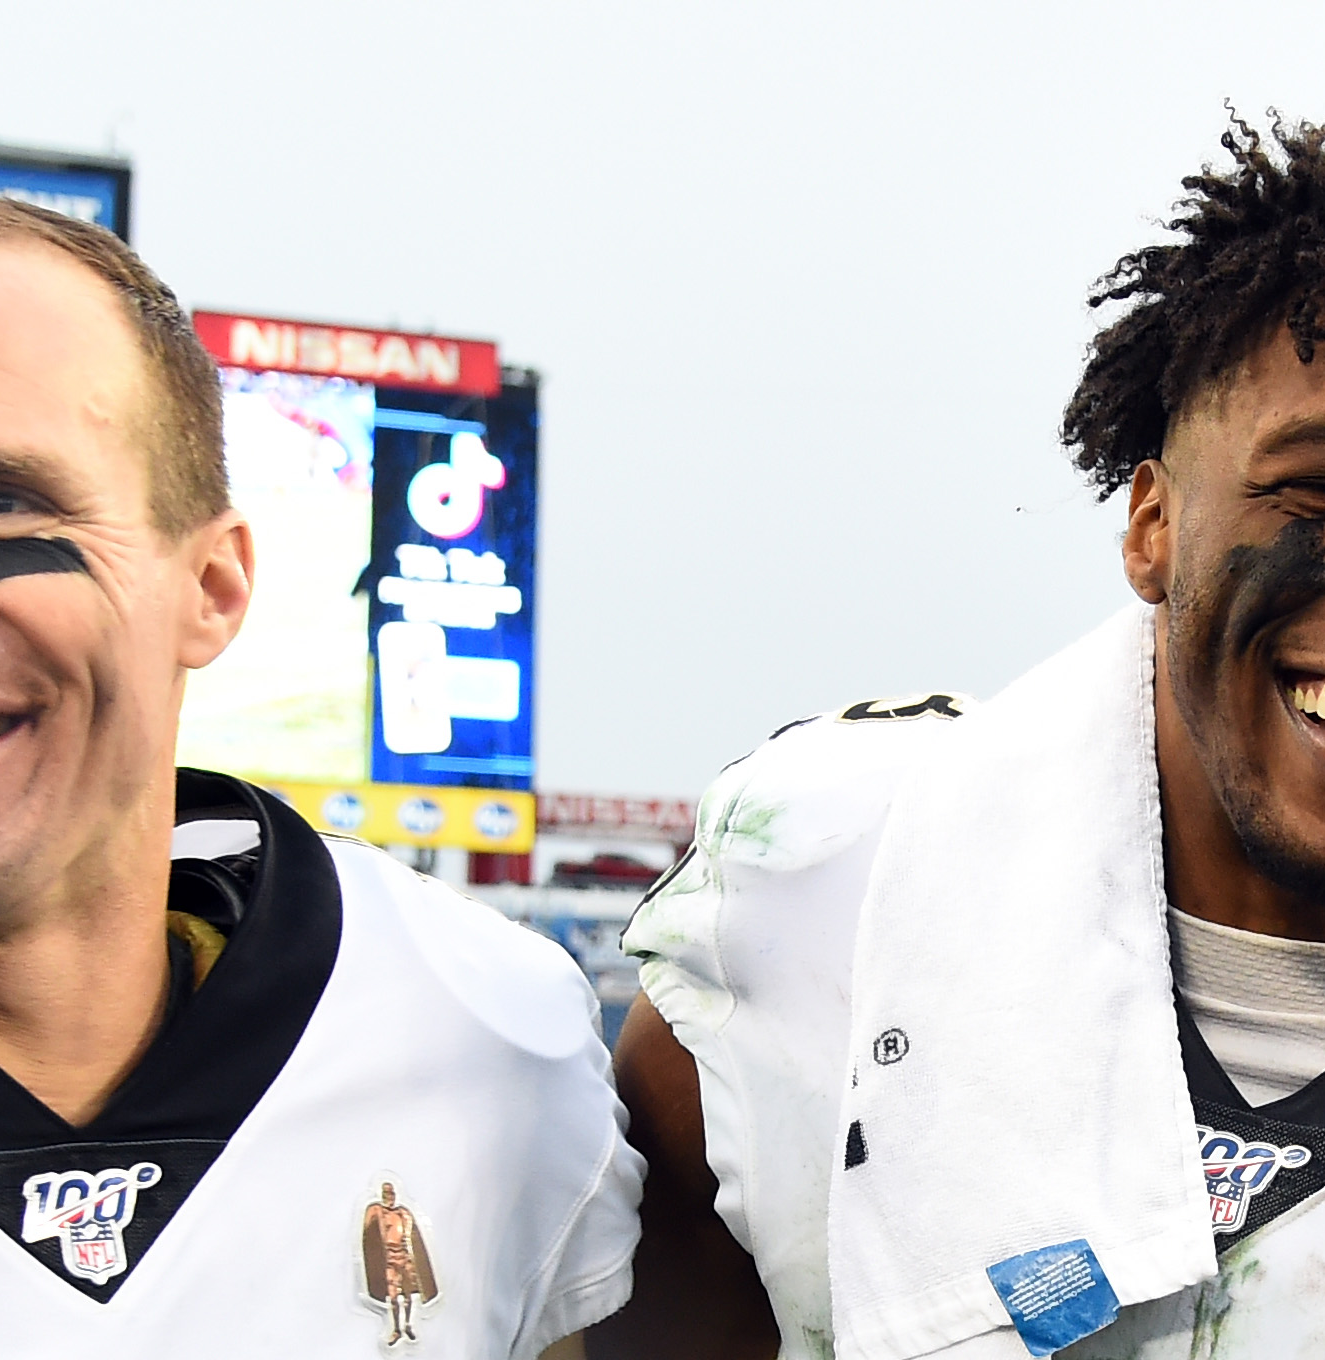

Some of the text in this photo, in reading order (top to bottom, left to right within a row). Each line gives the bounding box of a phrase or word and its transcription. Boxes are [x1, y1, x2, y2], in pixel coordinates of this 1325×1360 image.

[229, 317, 460, 387] NISSAN
[538, 792, 697, 828] NISSA
[75, 1241, 117, 1269] NFL
